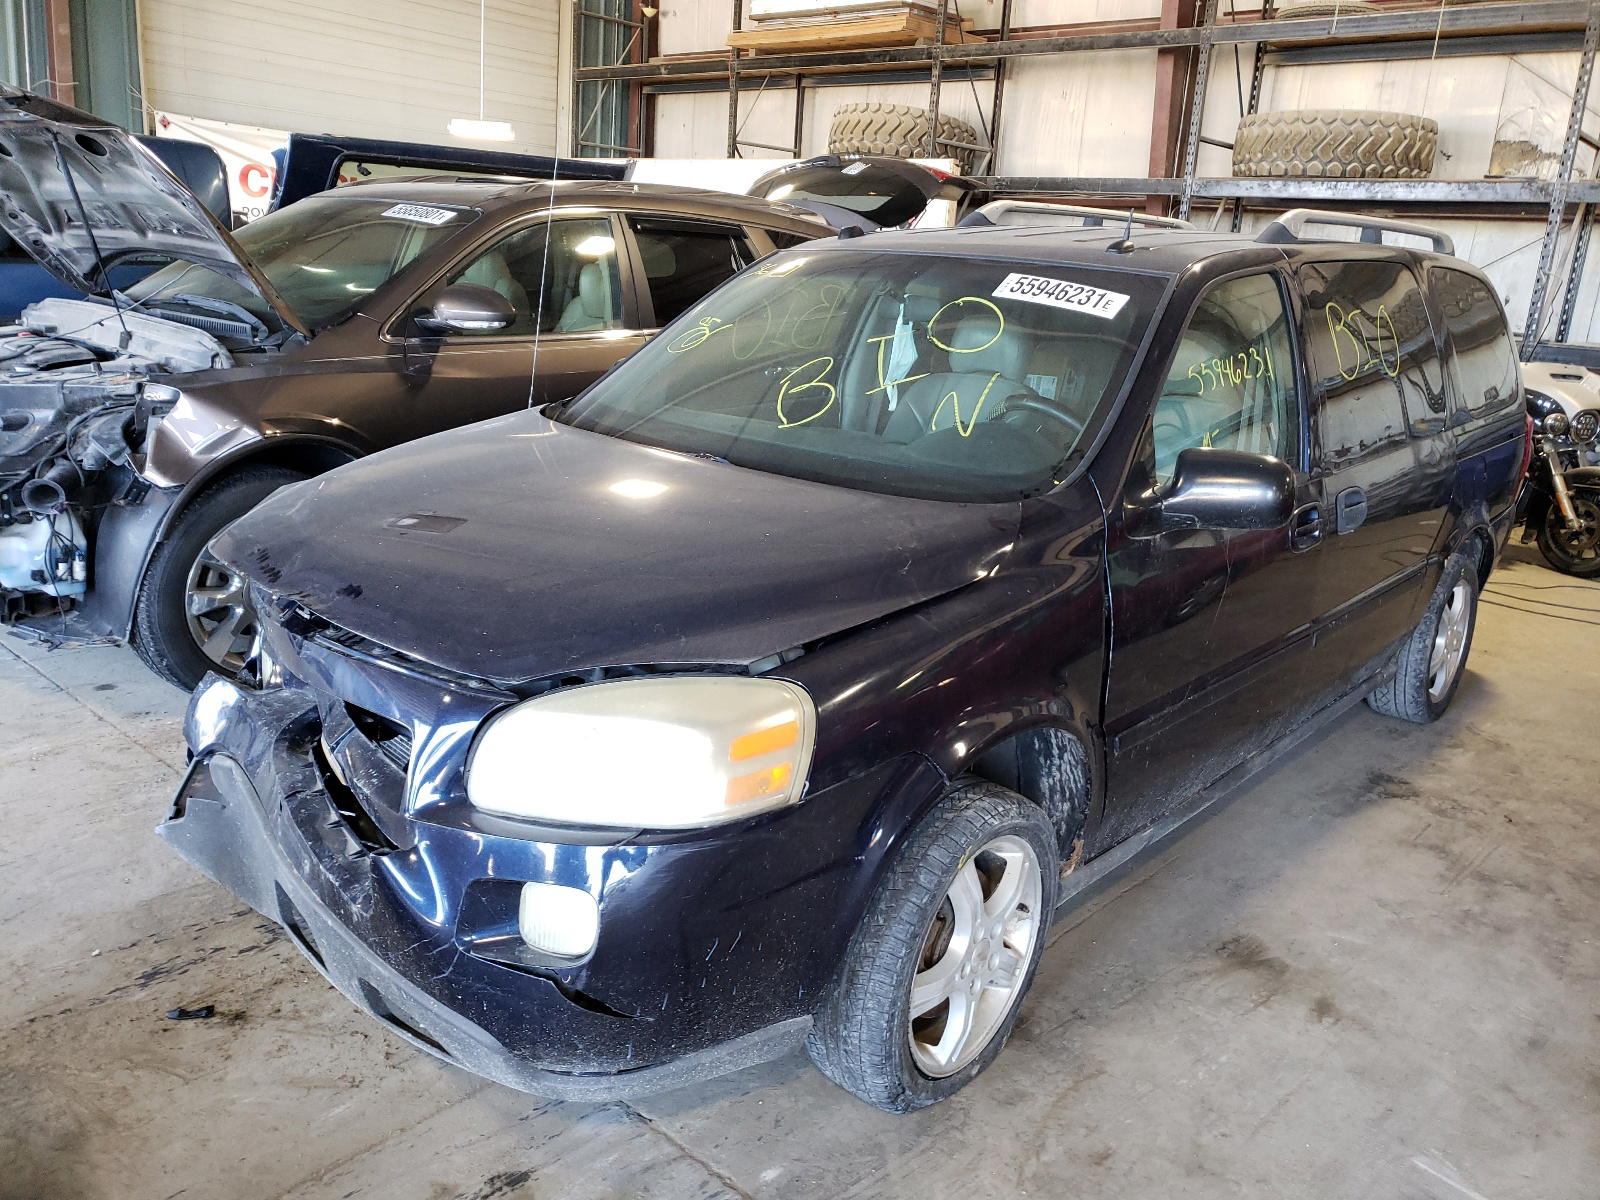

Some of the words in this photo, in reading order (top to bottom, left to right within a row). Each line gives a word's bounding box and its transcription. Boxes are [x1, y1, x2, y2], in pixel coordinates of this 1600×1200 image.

[1010, 276, 1107, 309] 55946231
[1103, 299, 1114, 311] E
[1187, 347, 1274, 396] 55946231
